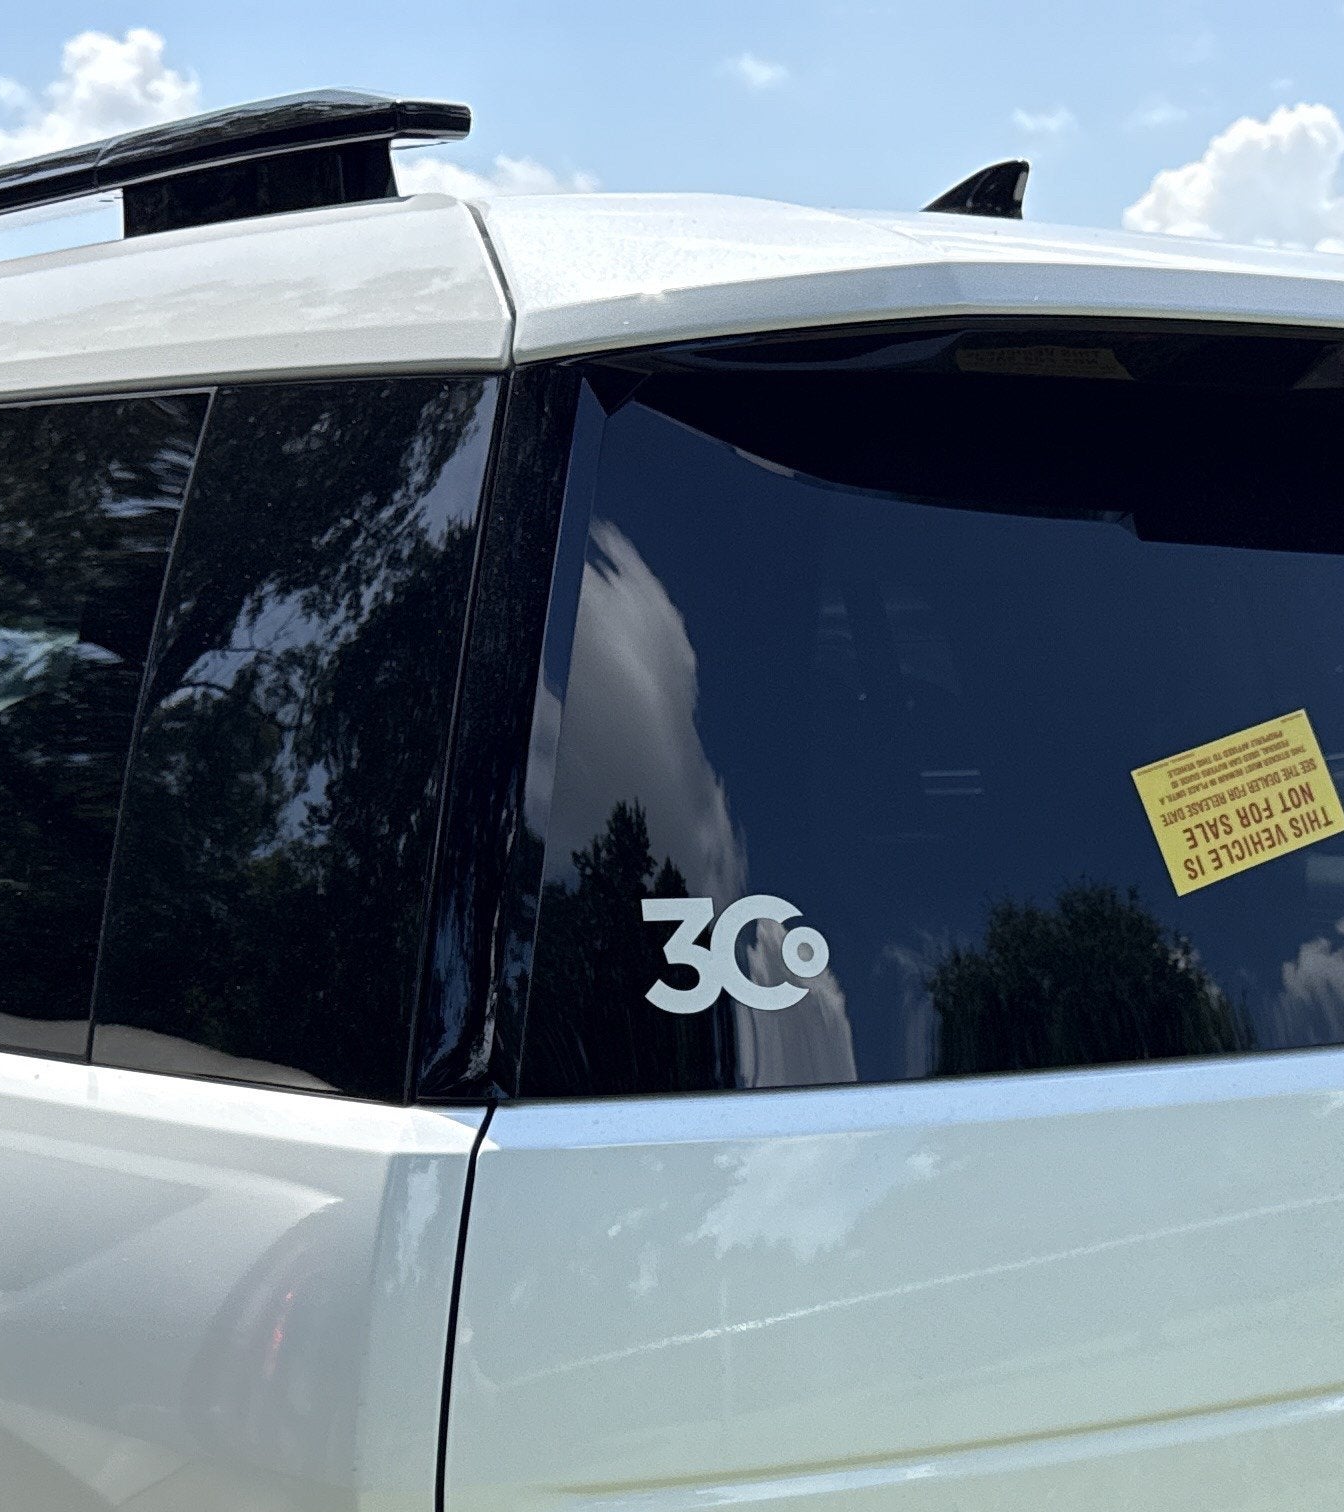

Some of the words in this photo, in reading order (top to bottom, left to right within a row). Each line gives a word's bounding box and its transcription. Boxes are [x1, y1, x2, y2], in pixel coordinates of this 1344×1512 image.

[1279, 763, 1299, 781] THE
[1298, 757, 1317, 774] SEE
[1226, 783, 1247, 801] FOR
[1245, 770, 1281, 794] DEALER
[1184, 791, 1227, 817] RELEASE
[1274, 781, 1315, 814] NOT
[1159, 807, 1186, 827] DATE
[1234, 796, 1275, 829] FOR
[1287, 804, 1333, 838] THIS
[1181, 812, 1234, 849] SALE
[1206, 822, 1287, 870] VEHICLE
[1182, 854, 1206, 880] IS
